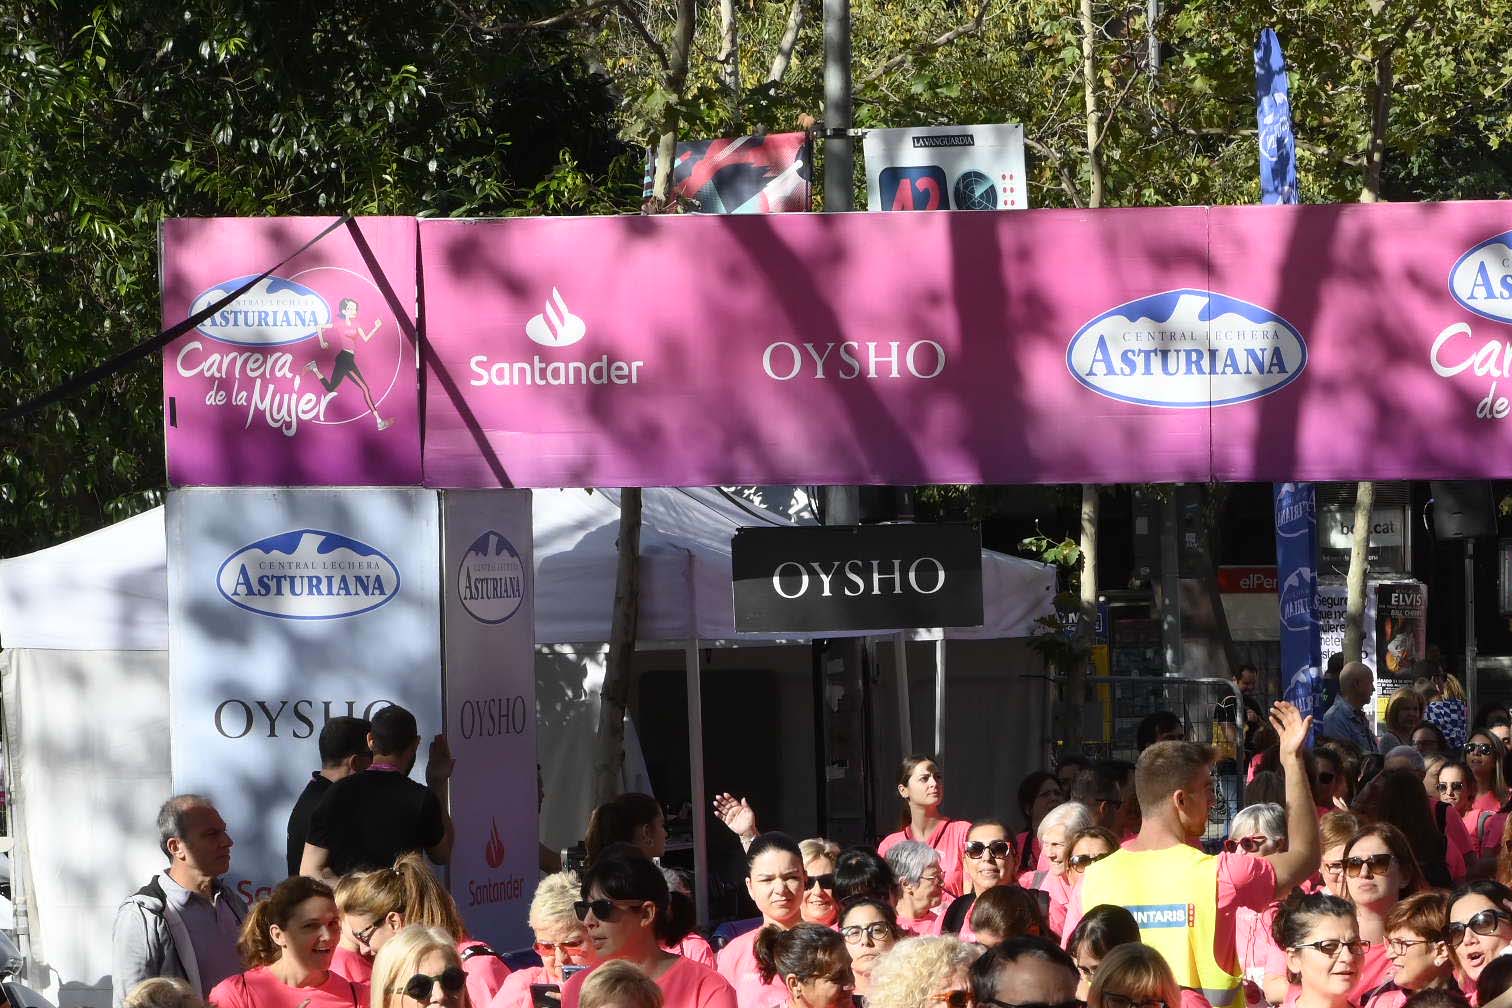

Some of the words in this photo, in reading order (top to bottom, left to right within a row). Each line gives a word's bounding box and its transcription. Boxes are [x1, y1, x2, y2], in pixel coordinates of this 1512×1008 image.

[925, 135, 974, 146] VANGUARDIA
[1123, 330, 1197, 342] CENTRAL
[1205, 329, 1281, 342] LECHERA
[176, 341, 294, 379] Carrera
[469, 355, 644, 387] Santander
[762, 340, 946, 381] OYSHO
[1085, 334, 1289, 377] ASTURIANA
[205, 379, 227, 406] de
[232, 379, 248, 406] la
[246, 374, 338, 437] Mujer
[1476, 381, 1510, 420] de
[231, 563, 387, 597] ASTURIANA
[259, 561, 318, 570] CENTRAL
[323, 561, 381, 570] LECHERA
[772, 557, 946, 599] OYSHO
[463, 566, 521, 602] ASTURIANA
[1391, 593, 1422, 606] ELVIS
[460, 695, 527, 740] OYSHO
[468, 874, 525, 908] Santander
